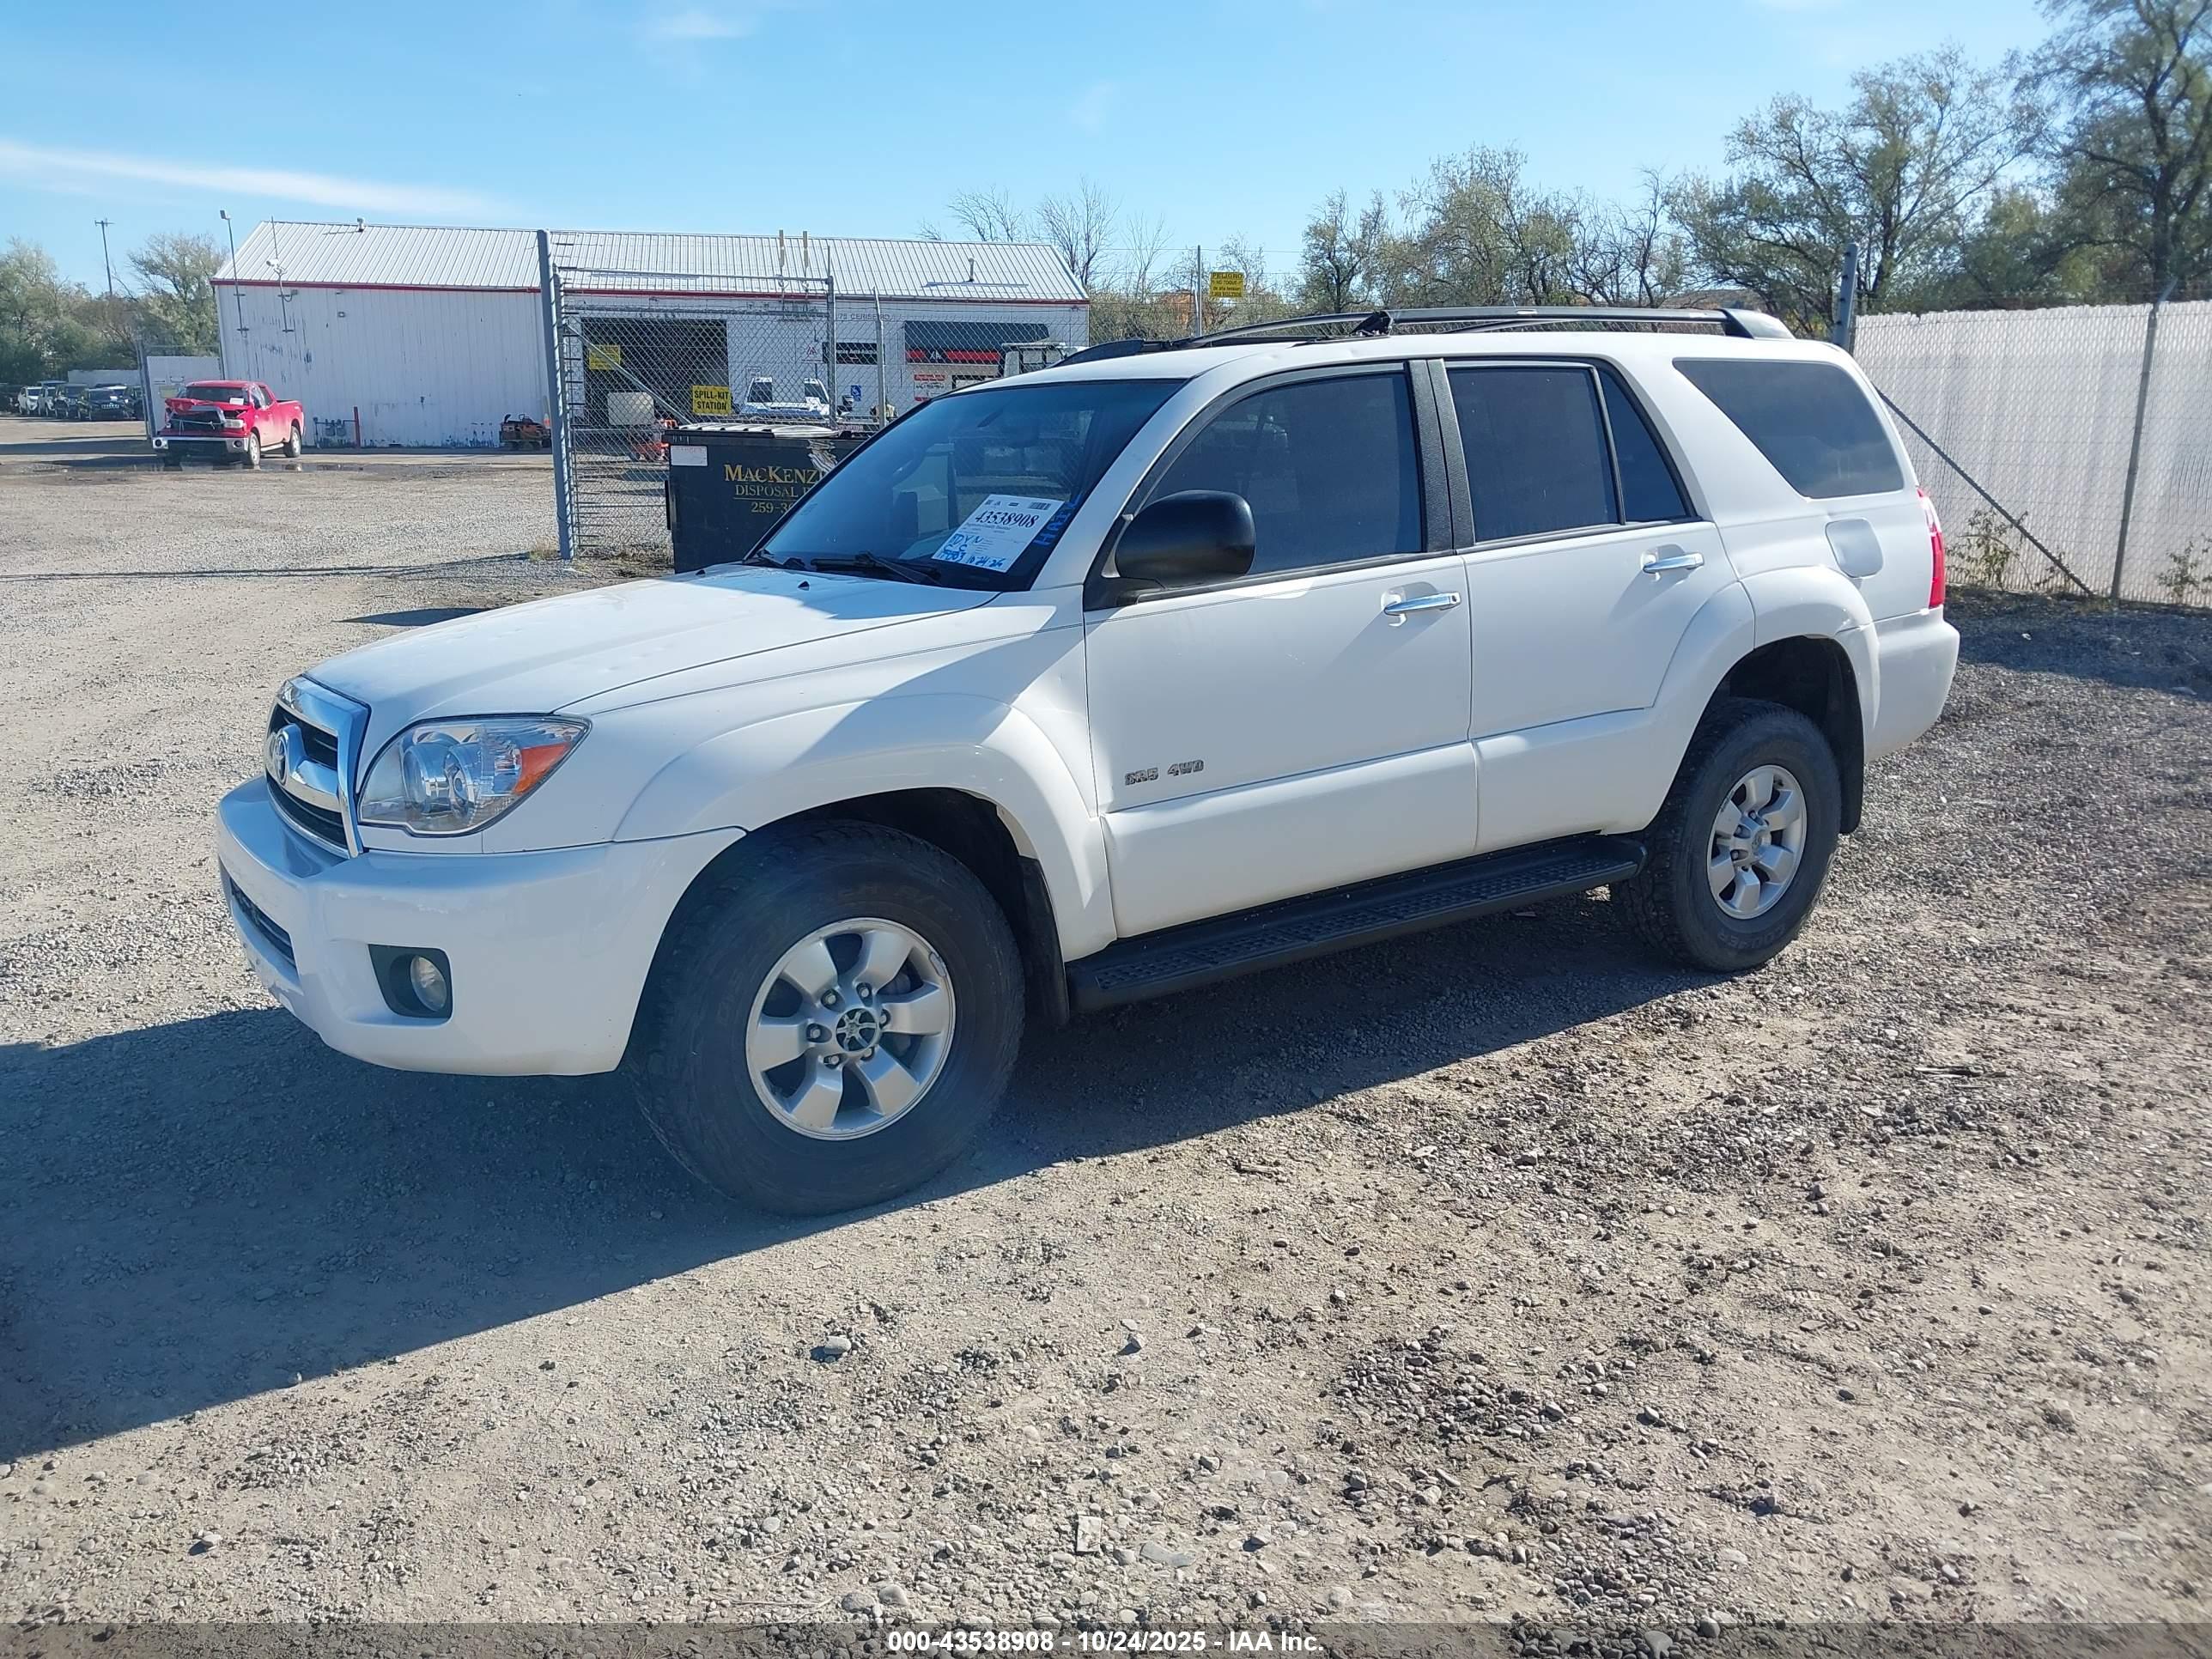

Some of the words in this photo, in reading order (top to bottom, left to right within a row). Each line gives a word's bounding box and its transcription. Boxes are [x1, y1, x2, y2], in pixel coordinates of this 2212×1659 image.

[694, 390, 729, 400] SPILL-KIT
[696, 400, 727, 410] STATION
[735, 485, 799, 498] DISPOSAL
[975, 511, 1040, 528] 43538908
[1125, 767, 1159, 786] SR5
[1167, 759, 1205, 776] 4WD
